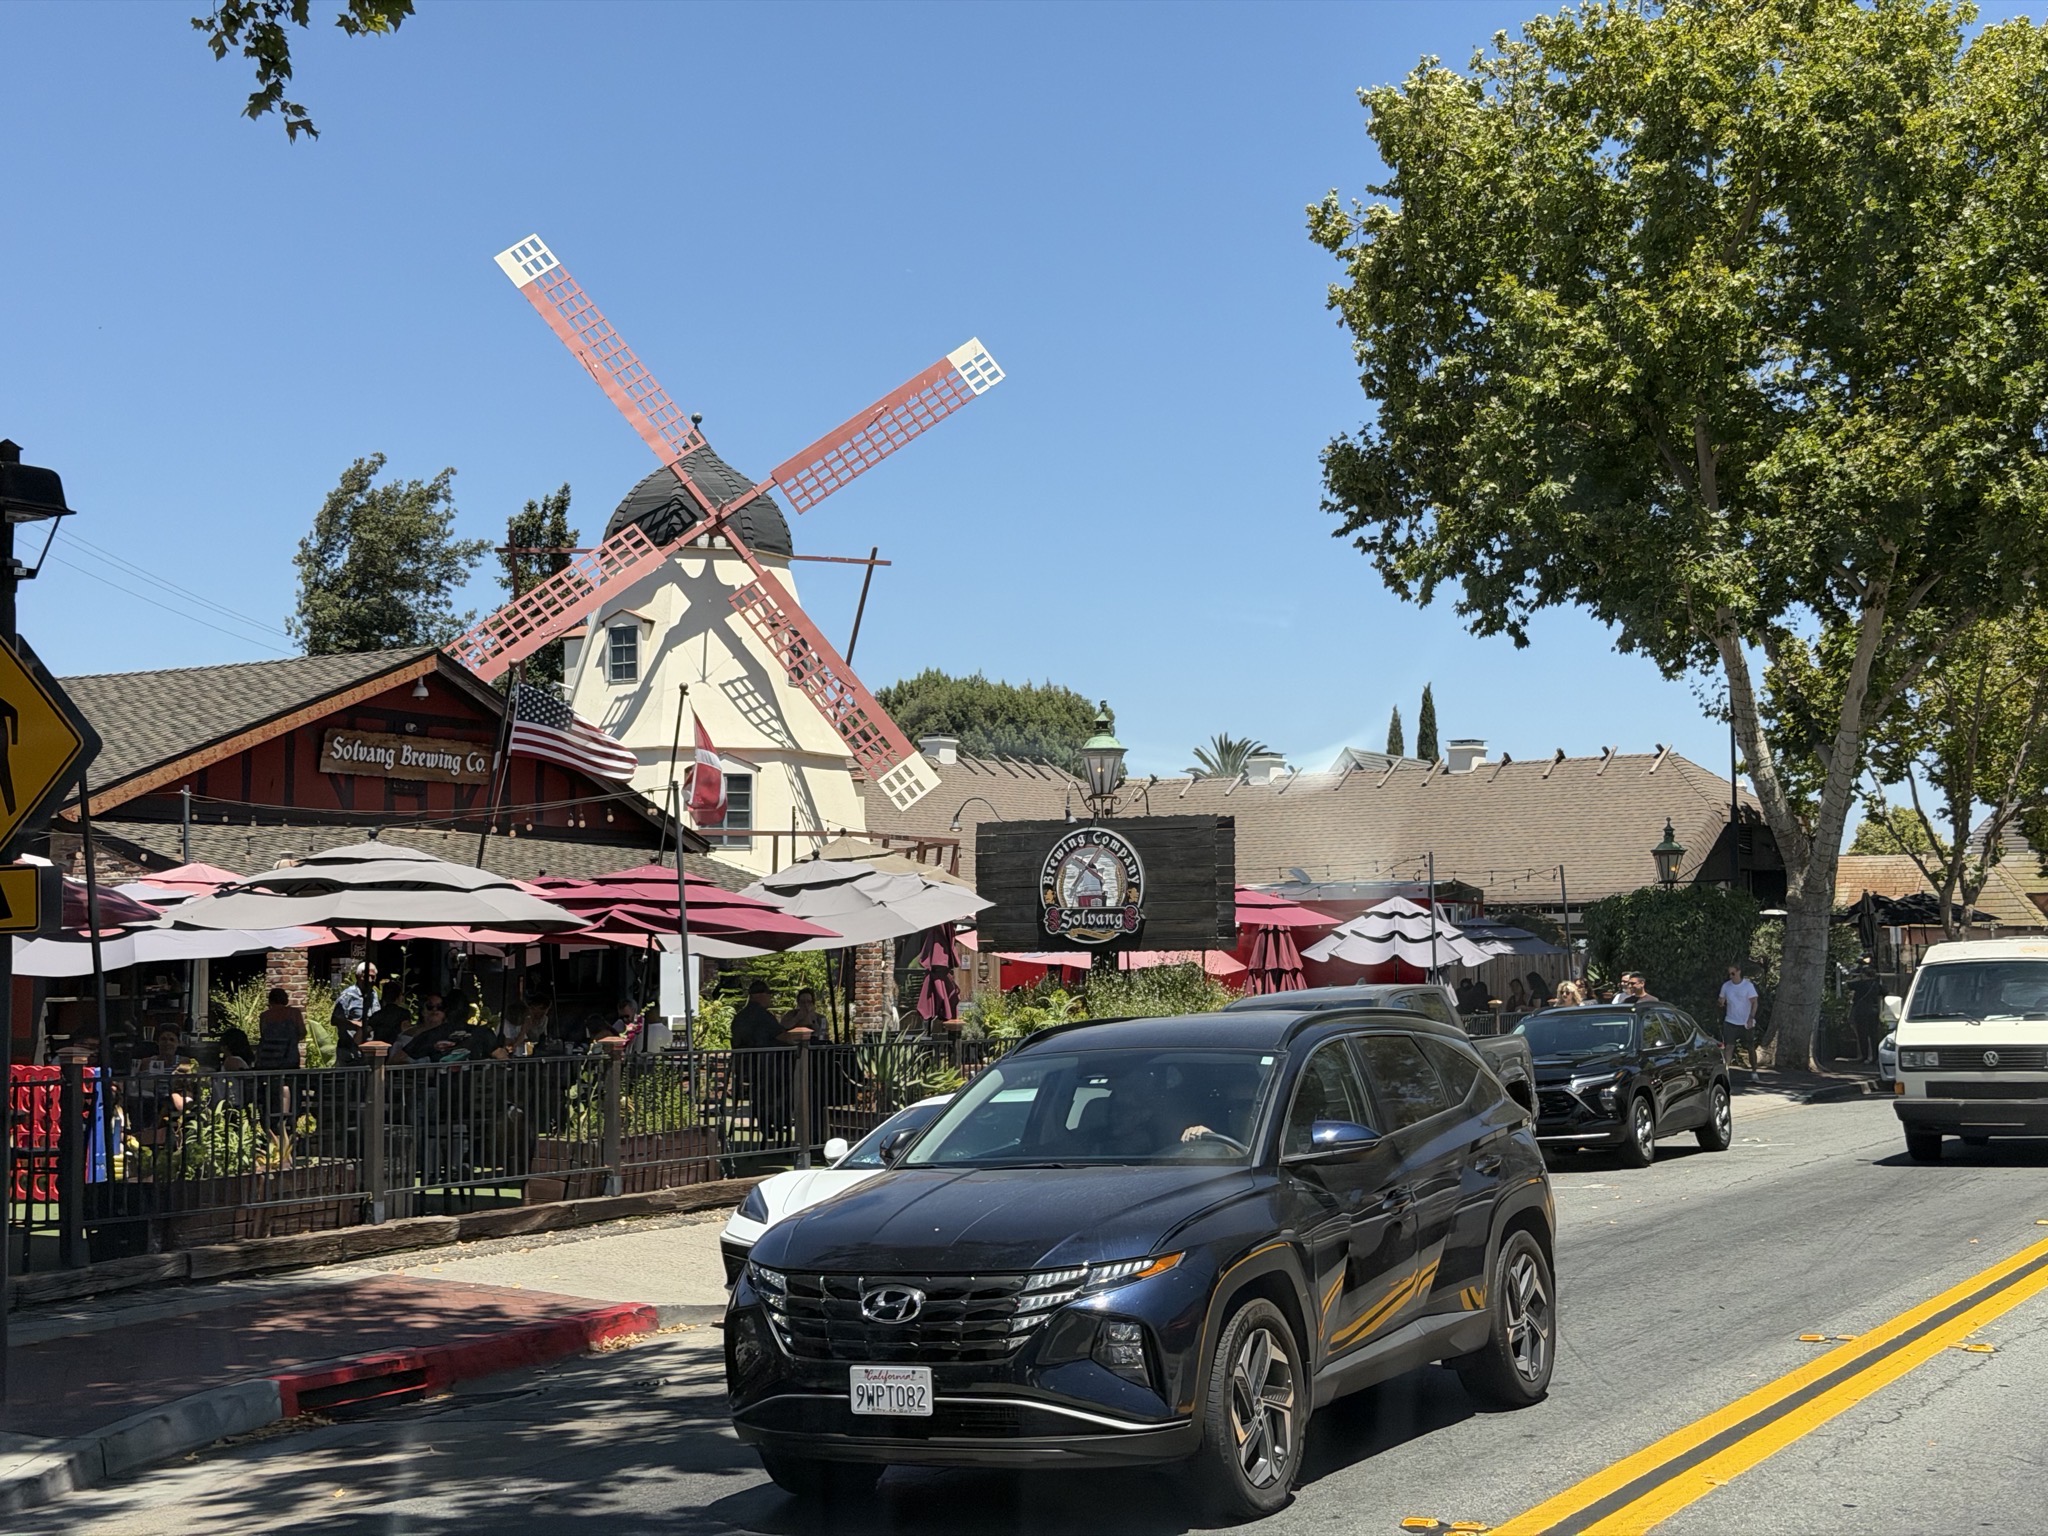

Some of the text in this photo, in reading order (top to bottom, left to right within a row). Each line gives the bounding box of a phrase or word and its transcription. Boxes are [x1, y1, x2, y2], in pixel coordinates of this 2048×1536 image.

[330, 735, 486, 776] Solvang Brewing Co.
[1043, 831, 1141, 886] Brewing Company
[1060, 909, 1124, 930] Solvang
[867, 1369, 912, 1383] California
[856, 1384, 926, 1408] 9WPT082
